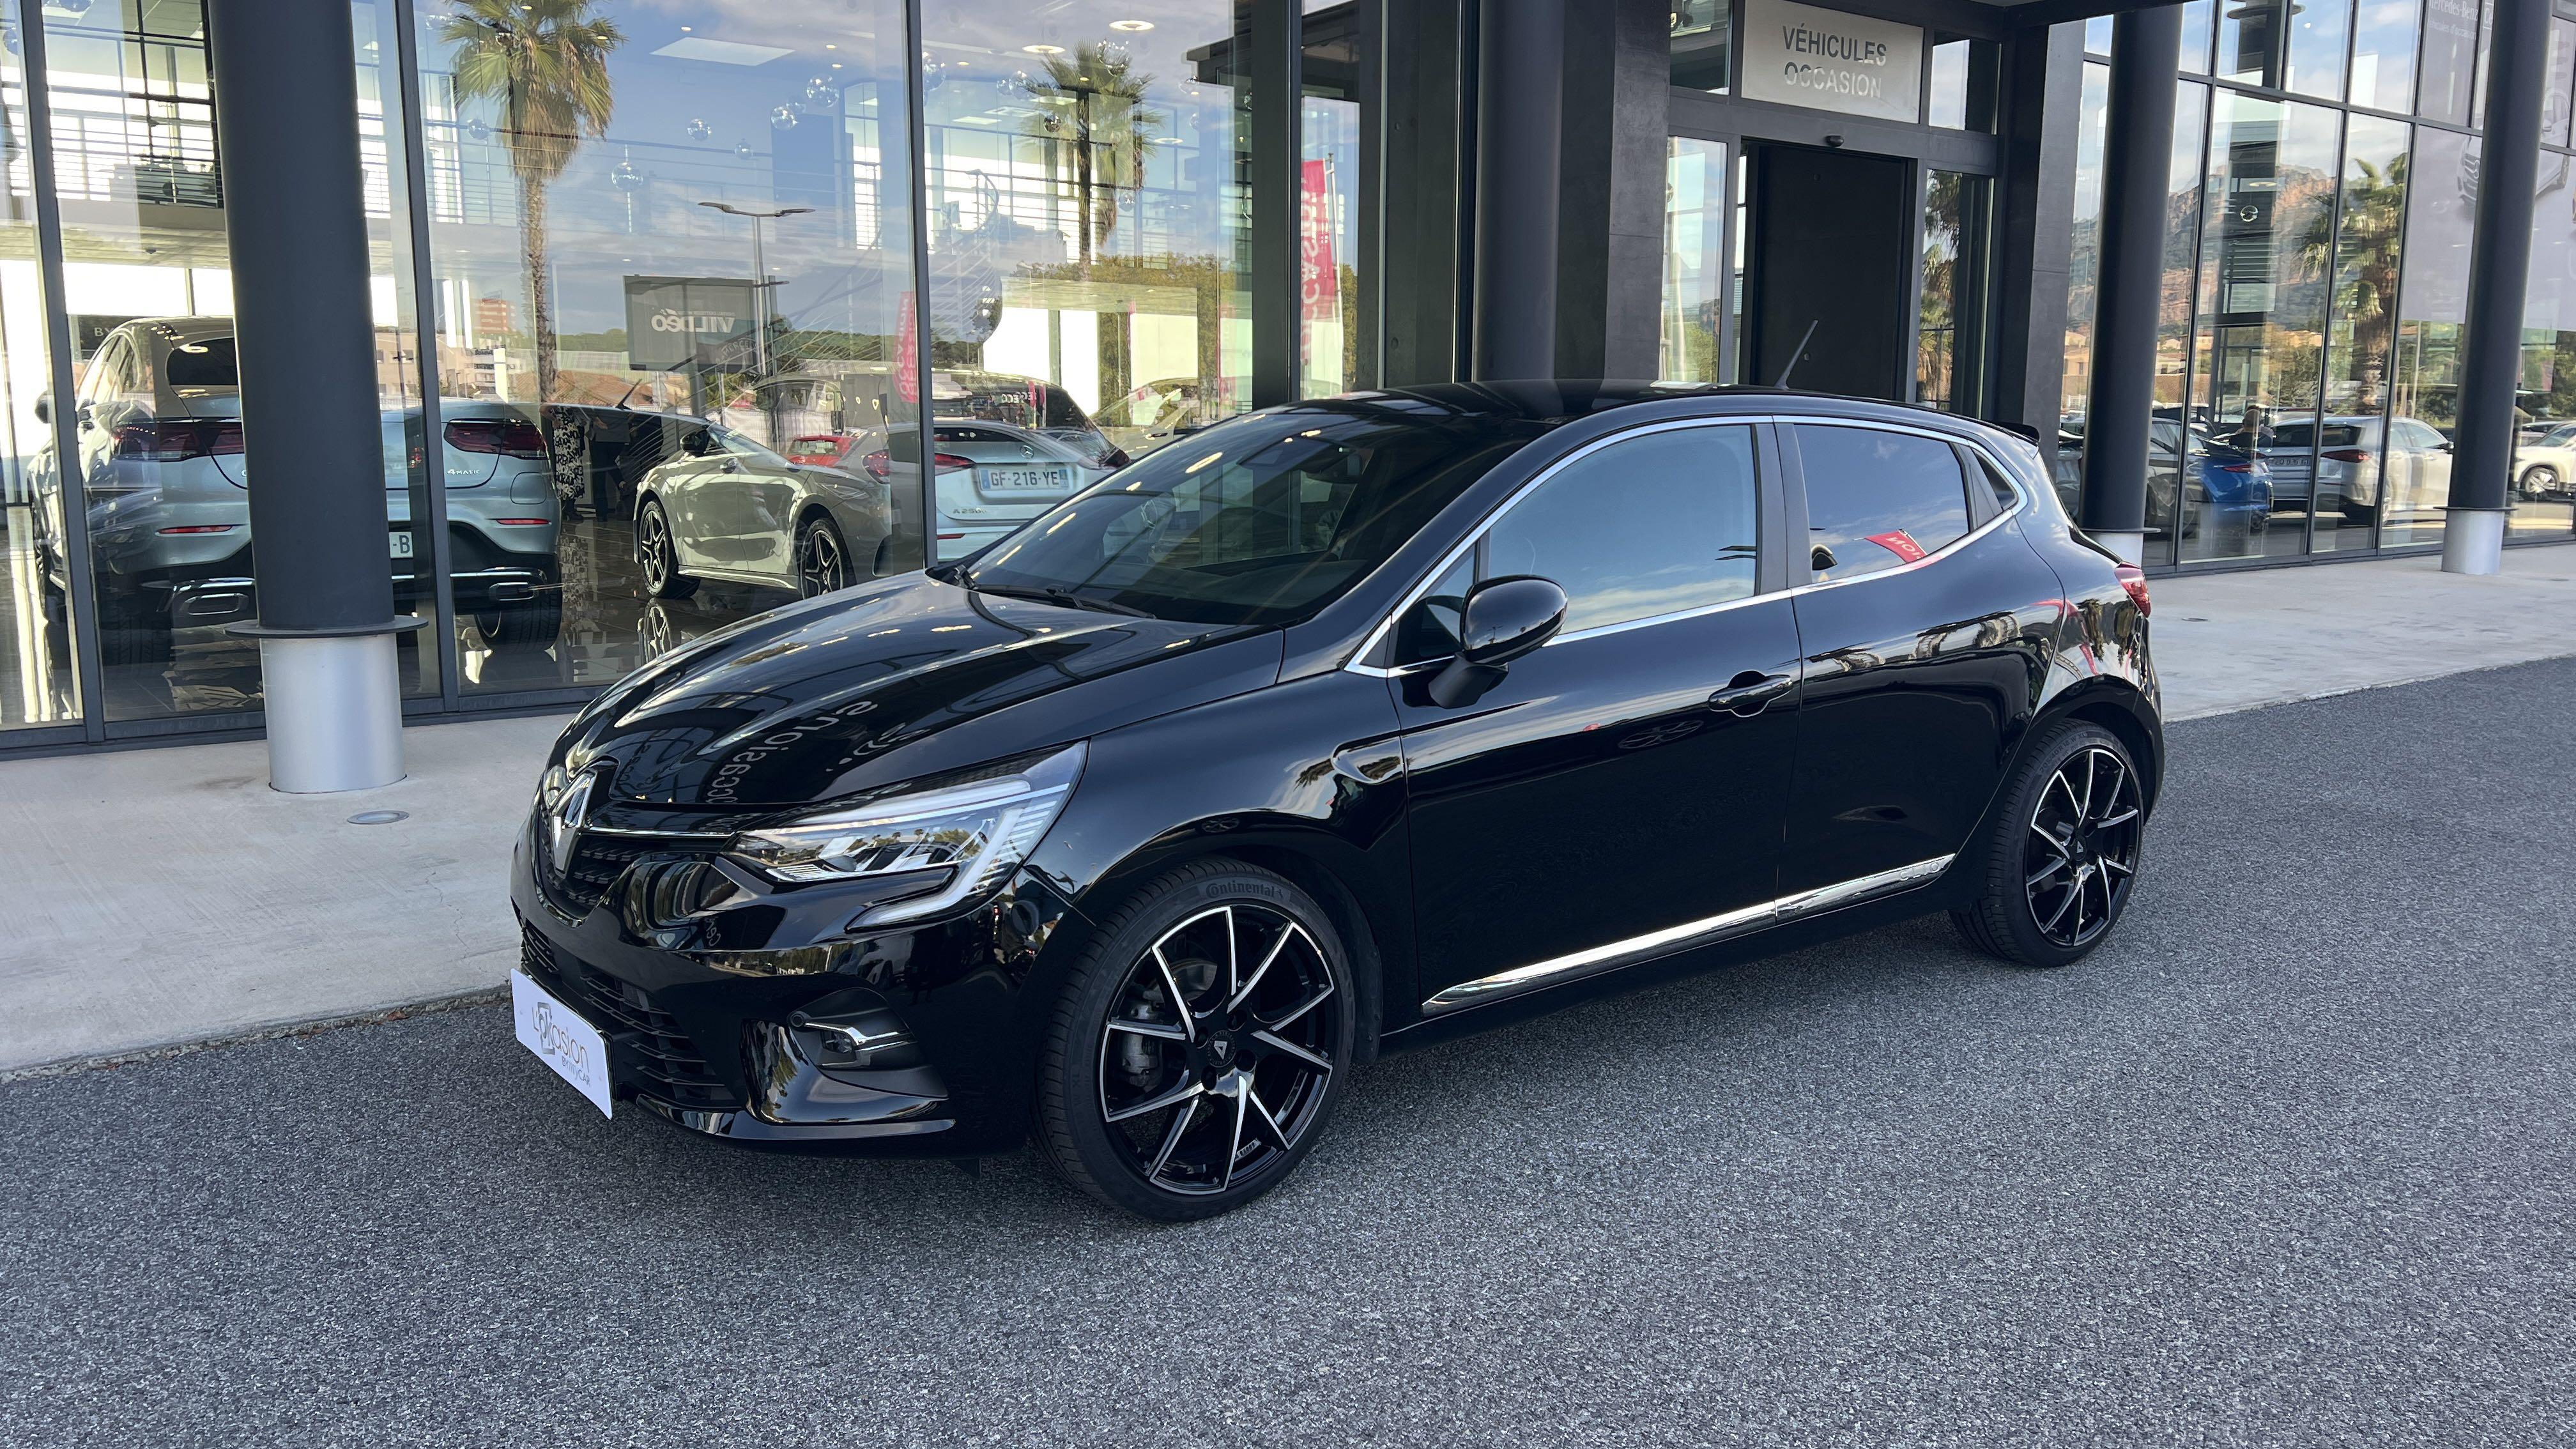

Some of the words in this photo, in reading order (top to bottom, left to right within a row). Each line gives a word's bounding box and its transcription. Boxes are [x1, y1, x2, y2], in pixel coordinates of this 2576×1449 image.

[1782, 22, 1887, 66] VÉHICULES
[1784, 61, 1882, 98] OCCASION
[1899, 862, 1940, 880] CLIO
[1206, 880, 1275, 898] Continental
